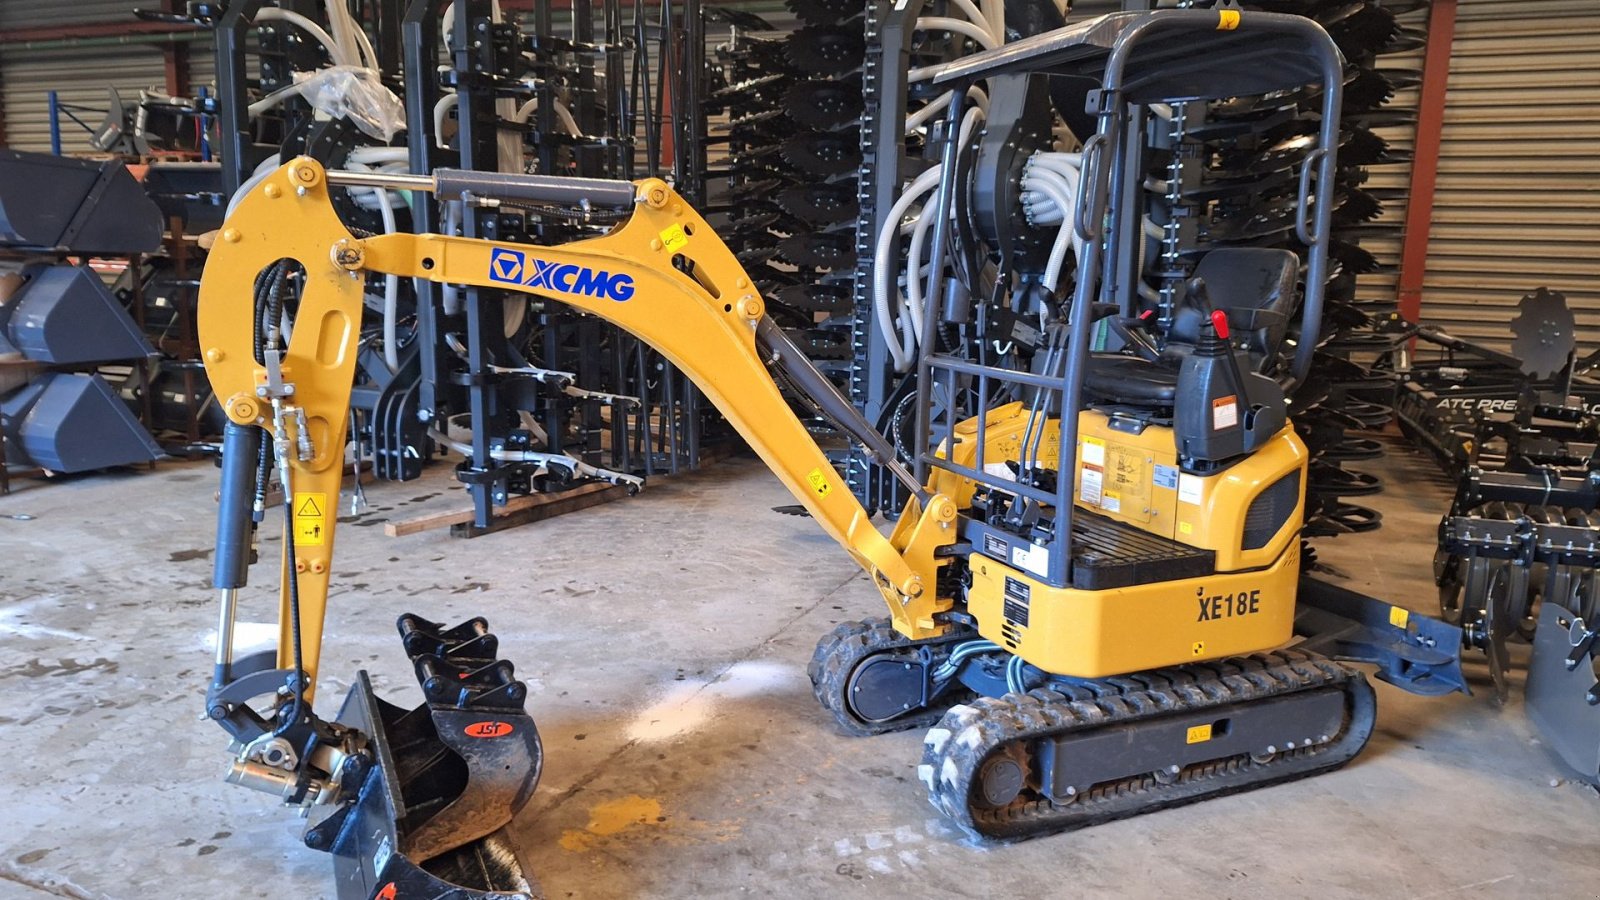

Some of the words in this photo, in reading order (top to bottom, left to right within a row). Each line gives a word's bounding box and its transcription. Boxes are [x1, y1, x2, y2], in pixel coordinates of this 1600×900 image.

[523, 259, 635, 302] XCMG
[1436, 398, 1475, 409] ATC
[1477, 399, 1518, 411] PRE
[1197, 590, 1261, 622] XE18E
[477, 724, 502, 735] JST
